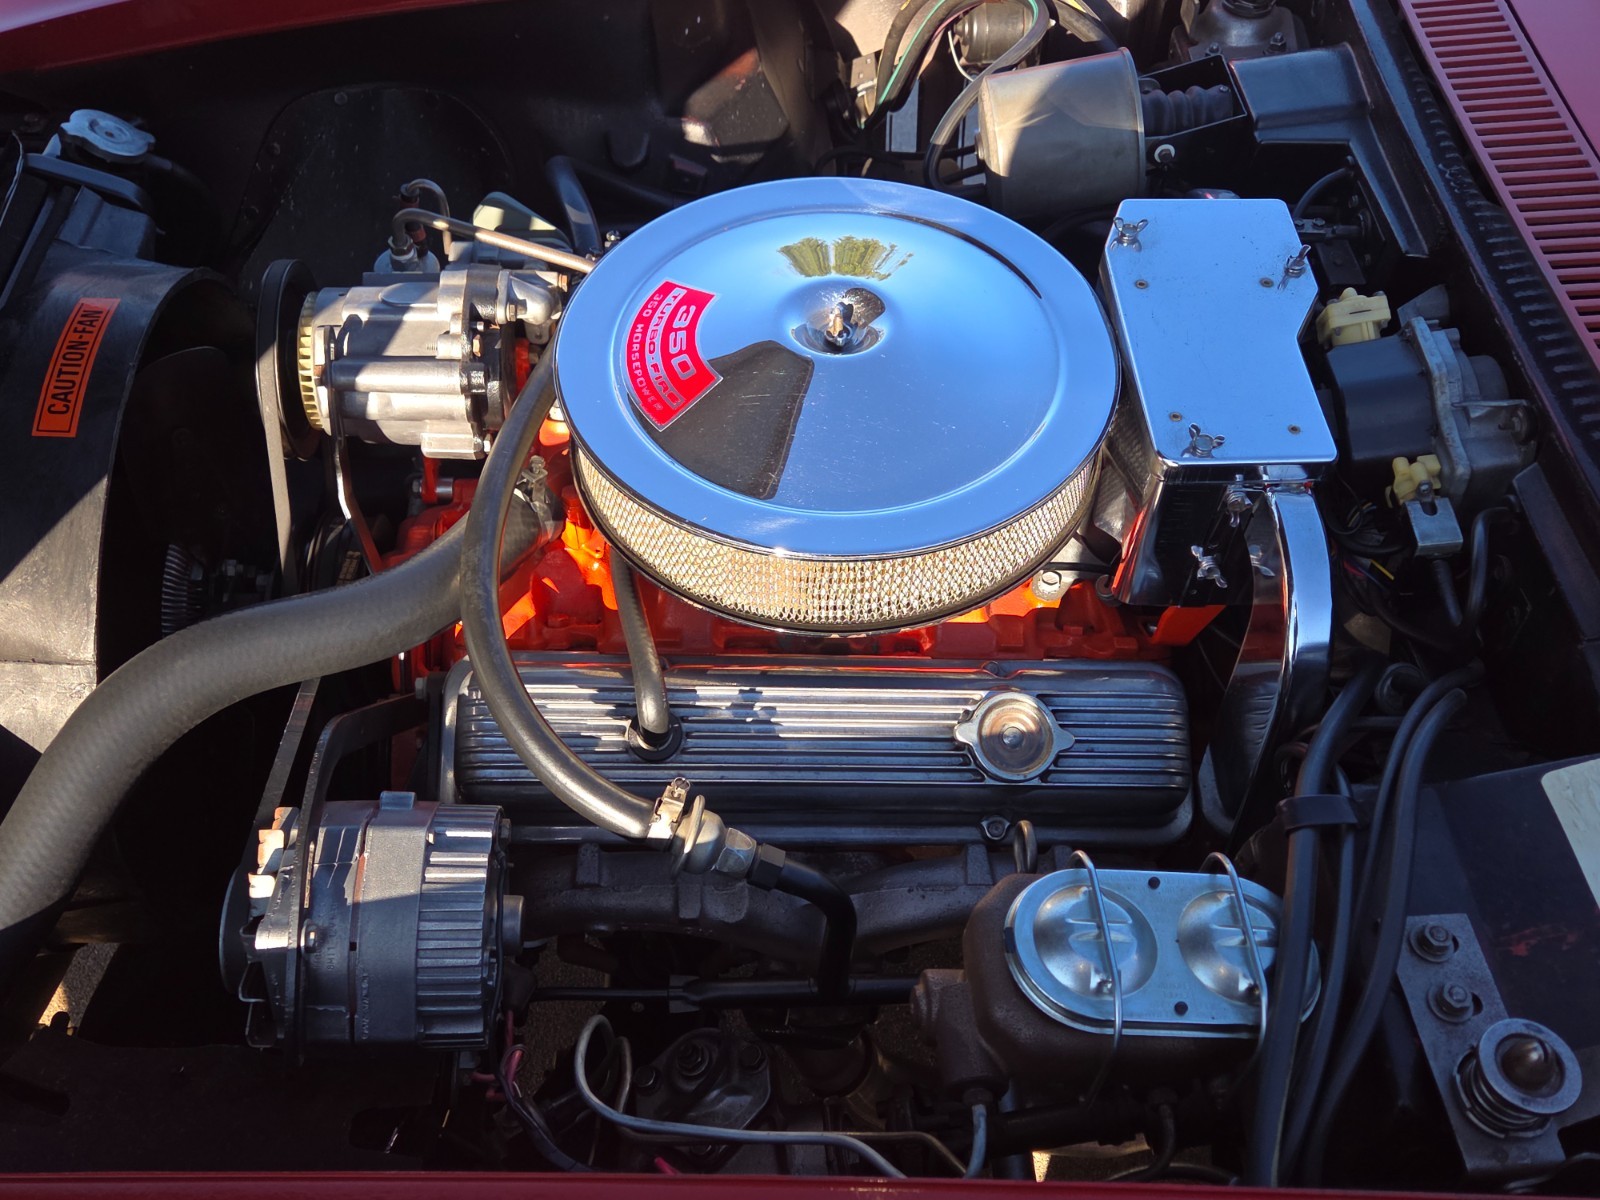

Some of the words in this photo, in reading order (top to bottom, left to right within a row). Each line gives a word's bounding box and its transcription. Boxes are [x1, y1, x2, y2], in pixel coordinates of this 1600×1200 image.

[642, 293, 663, 318] 350
[668, 304, 697, 381] 350
[47, 309, 104, 416] CAUTION-FAN
[631, 323, 664, 411] HORSEPOWER
